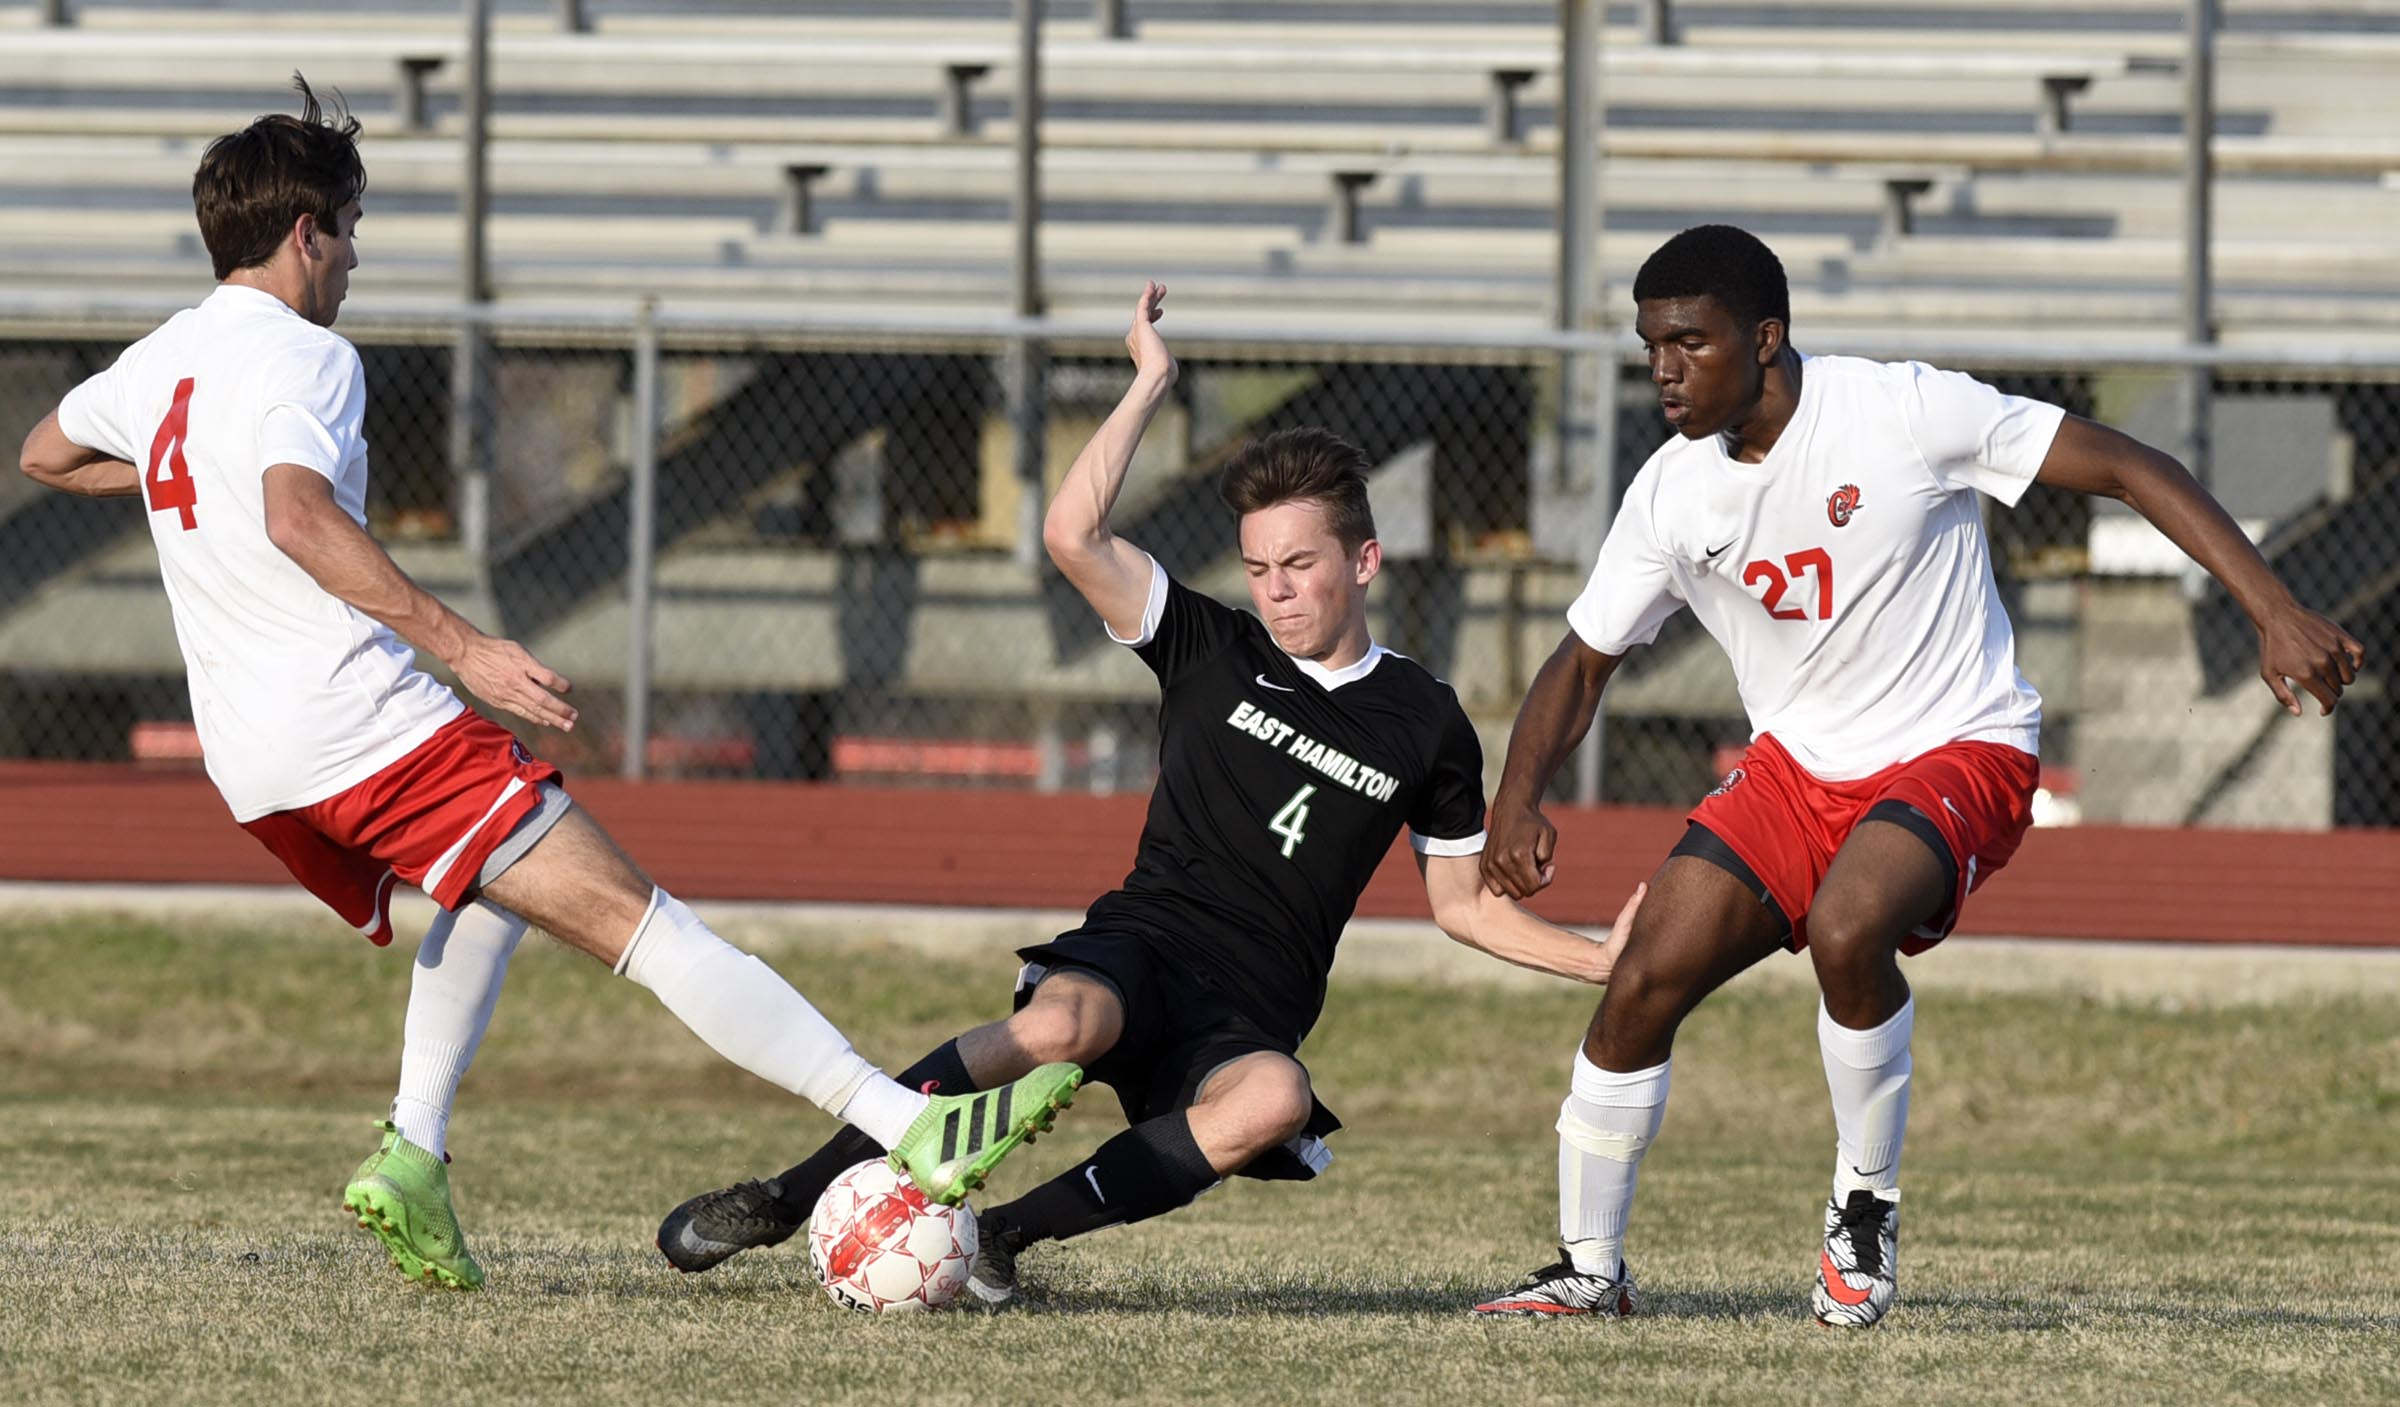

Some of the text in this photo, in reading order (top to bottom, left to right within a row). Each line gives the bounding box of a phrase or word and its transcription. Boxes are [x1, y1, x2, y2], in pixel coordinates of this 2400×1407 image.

[146, 377, 198, 531] 4
[1743, 547, 1833, 620] 27
[1227, 701, 1400, 803] EAST HAMILTON
[1268, 783, 1318, 860] 4
